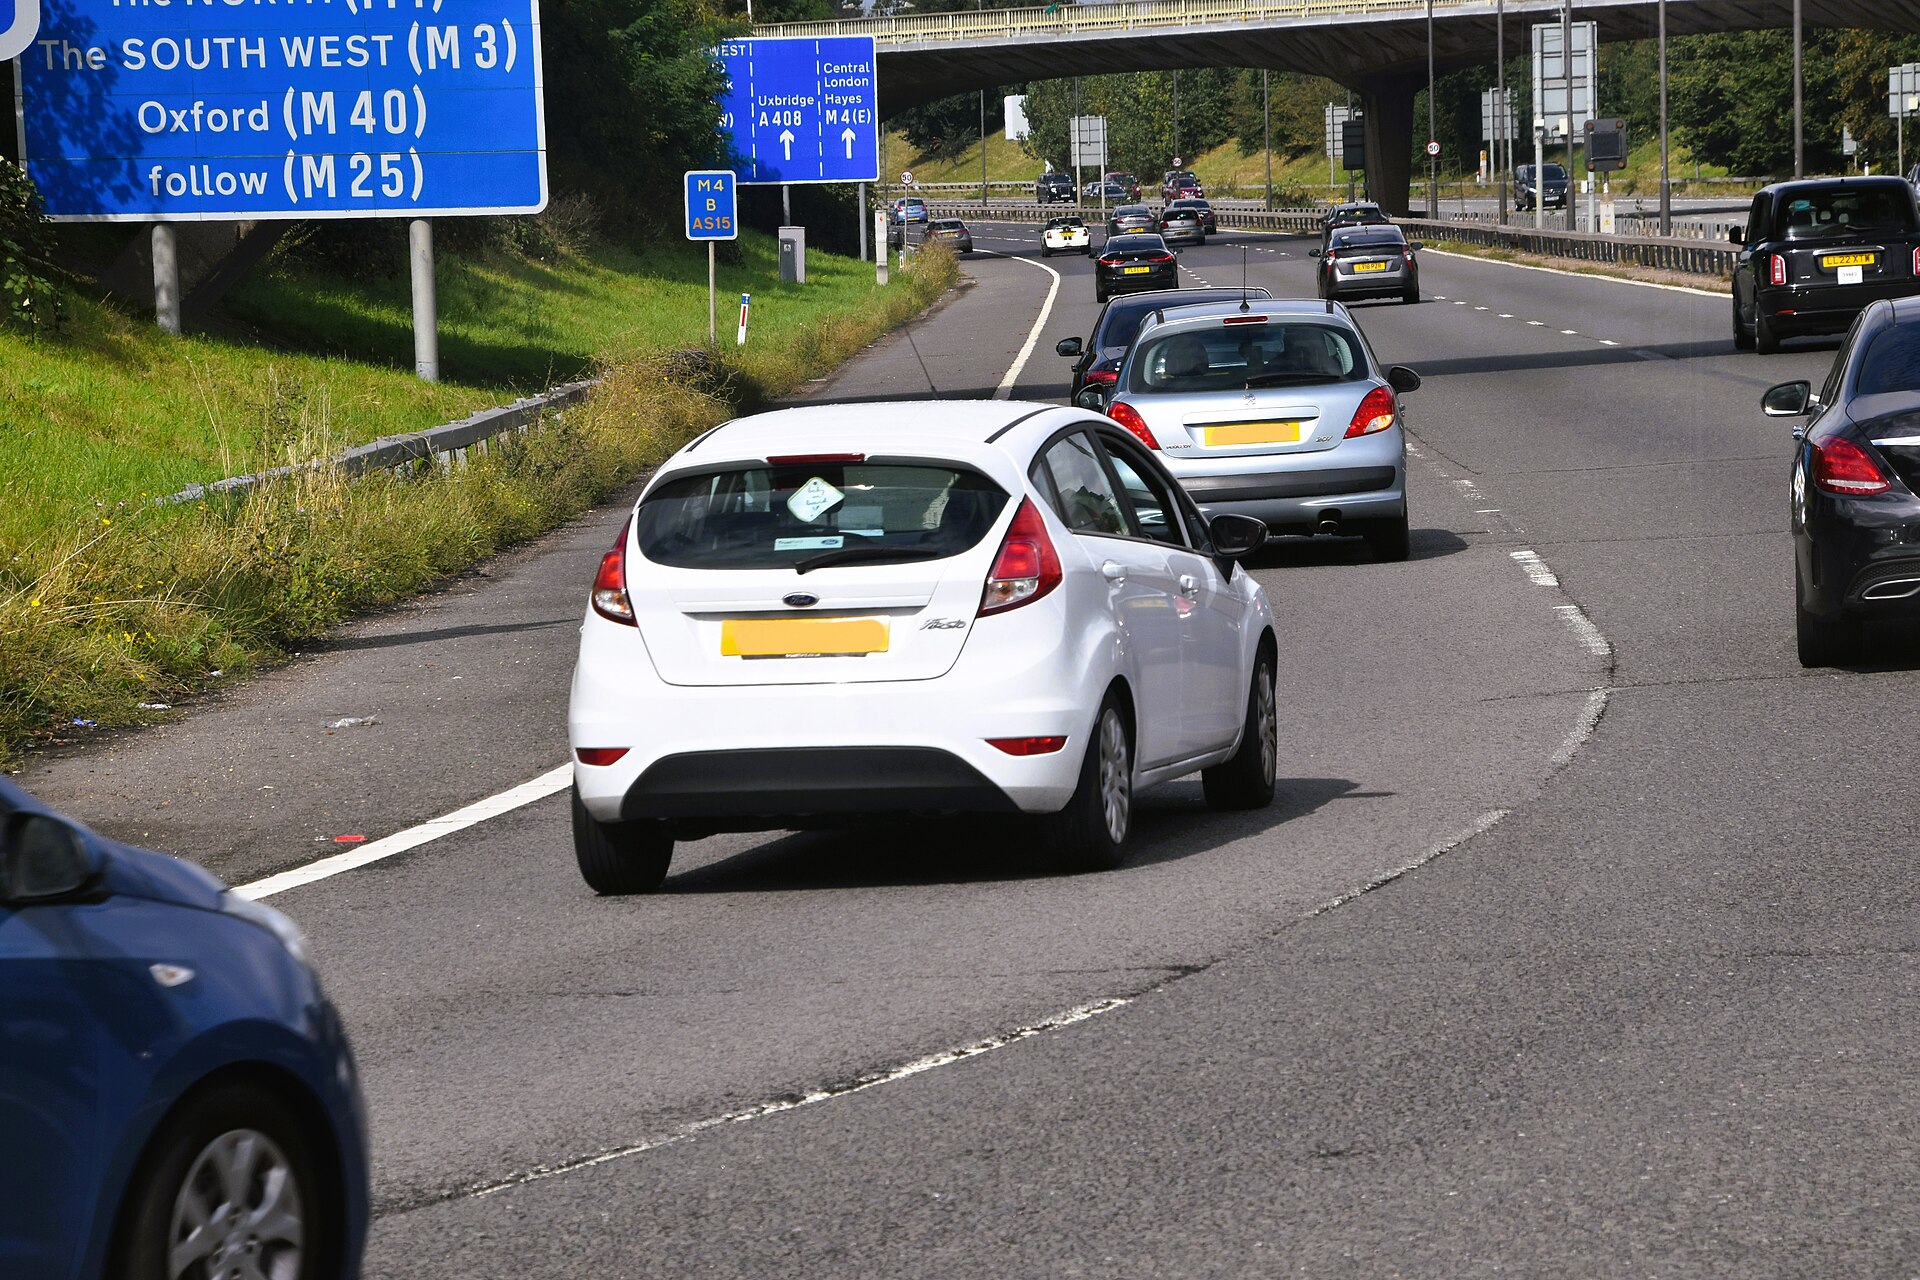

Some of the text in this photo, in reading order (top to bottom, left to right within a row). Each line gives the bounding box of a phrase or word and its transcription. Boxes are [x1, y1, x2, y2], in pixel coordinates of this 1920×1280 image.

[37, 39, 107, 71] The
[122, 37, 266, 71] SOUTH
[279, 34, 394, 68] WEST
[823, 61, 870, 74] Central
[824, 75, 869, 88] London
[758, 94, 815, 107] Uxbridge
[825, 93, 862, 106] Hayes
[137, 100, 269, 134] Oxford
[1429, 144, 1438, 152] 50
[148, 164, 268, 197] follow
[902, 174, 912, 182] 50
[706, 198, 717, 211] B
[692, 216, 731, 230] AS15
